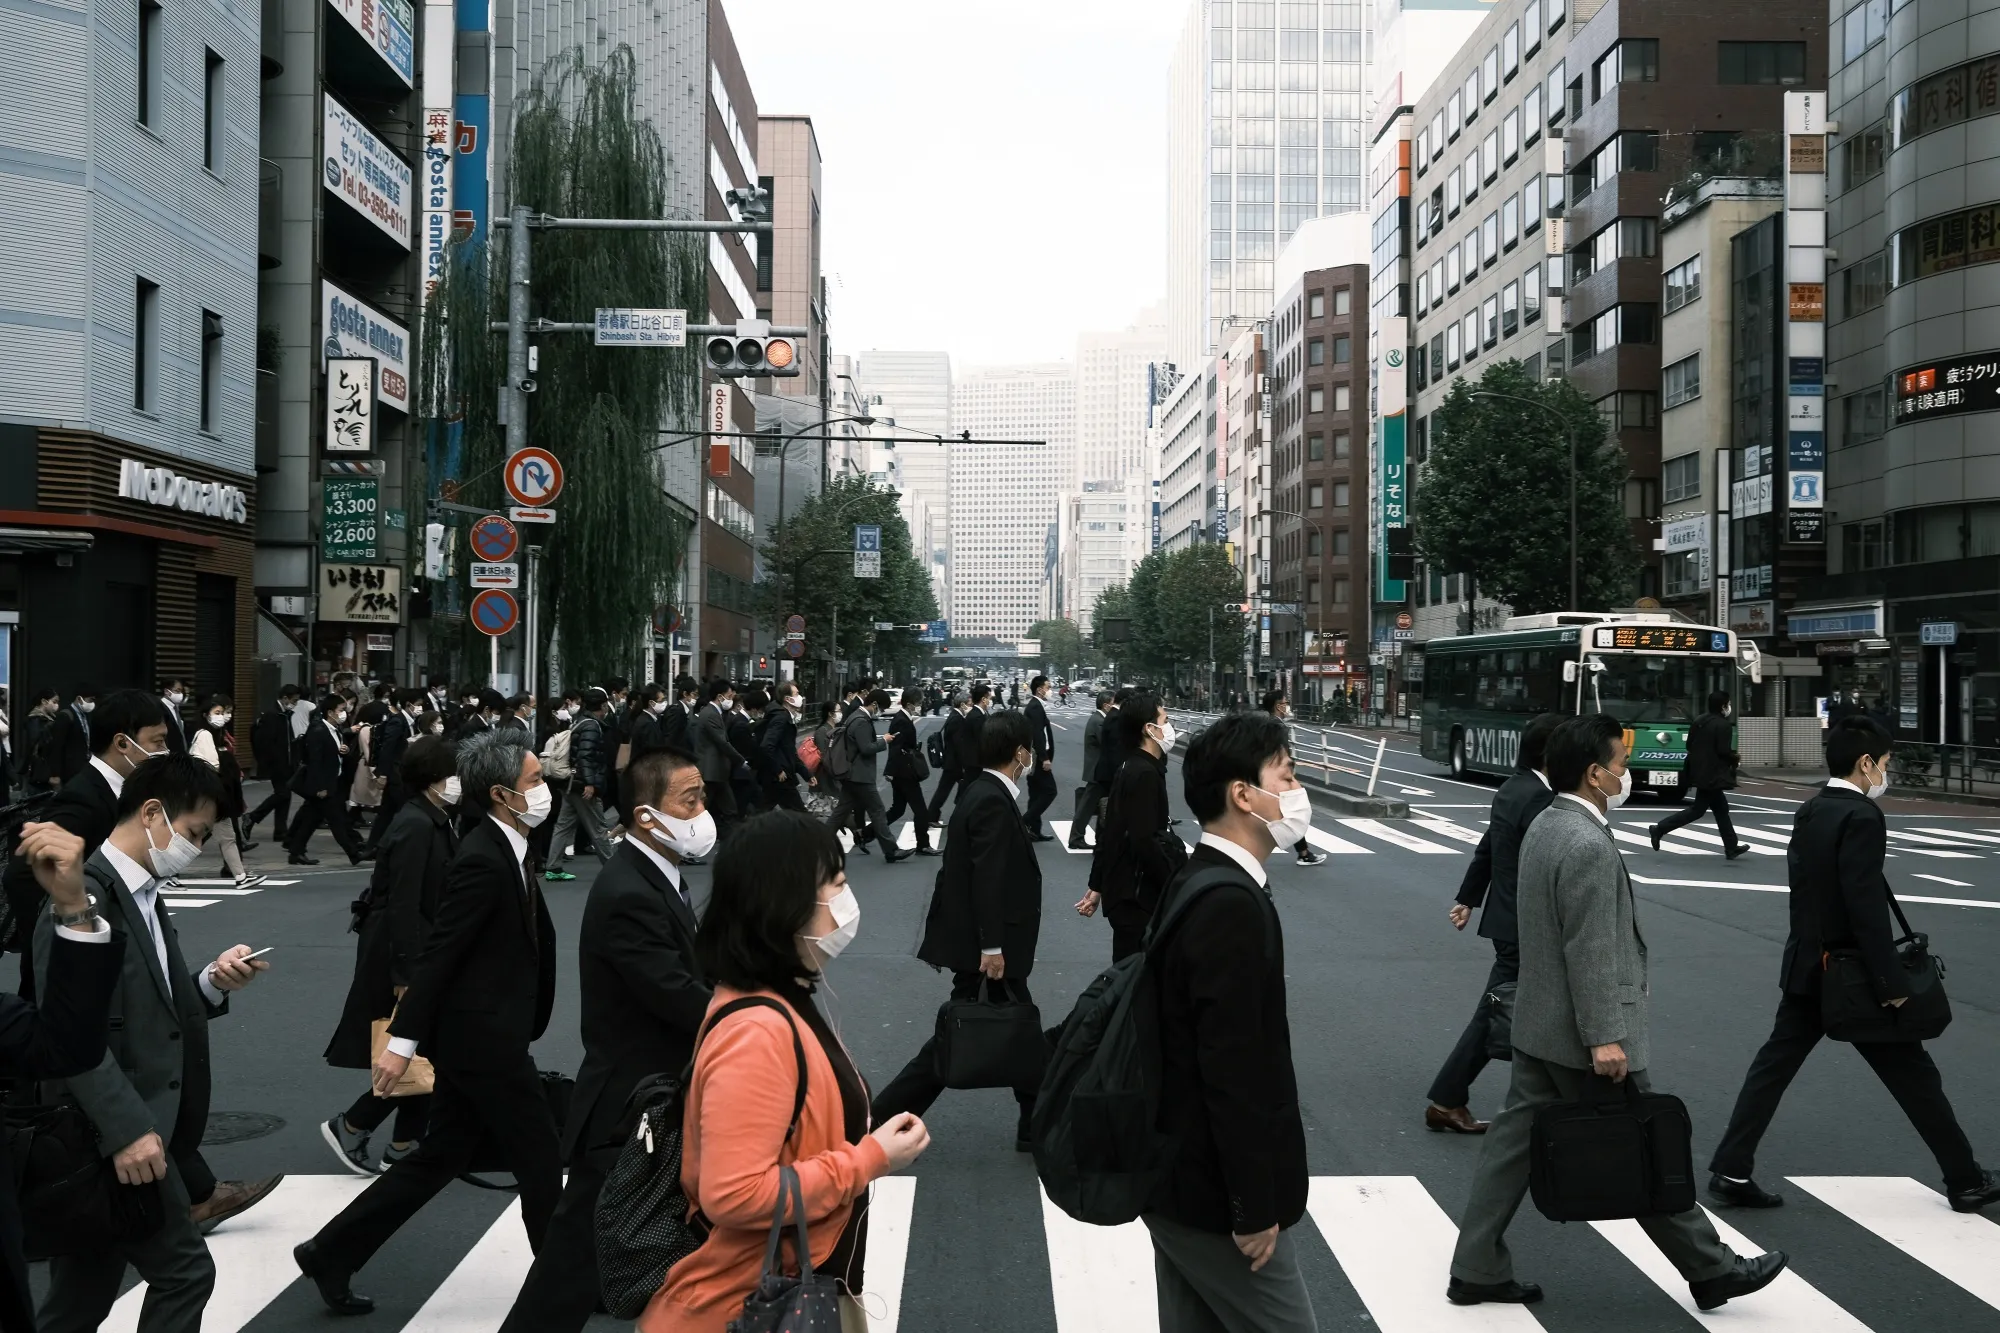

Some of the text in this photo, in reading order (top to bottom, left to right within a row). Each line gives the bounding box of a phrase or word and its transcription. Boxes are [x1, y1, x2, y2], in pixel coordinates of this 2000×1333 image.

[330, 295, 404, 365] gosta annex
[598, 314, 683, 331] 新橋駅日比谷口前
[599, 331, 681, 343] Shinbashi Sta. Hibiya
[118, 458, 247, 524] McDonald's
[325, 480, 377, 492] シャンプー・カット
[325, 497, 377, 516] ¥3,300
[325, 518, 377, 530] シャンプー・カット
[325, 526, 377, 545] ¥2,600
[327, 566, 386, 590] いきなり
[1476, 728, 1522, 768] XYLITO
